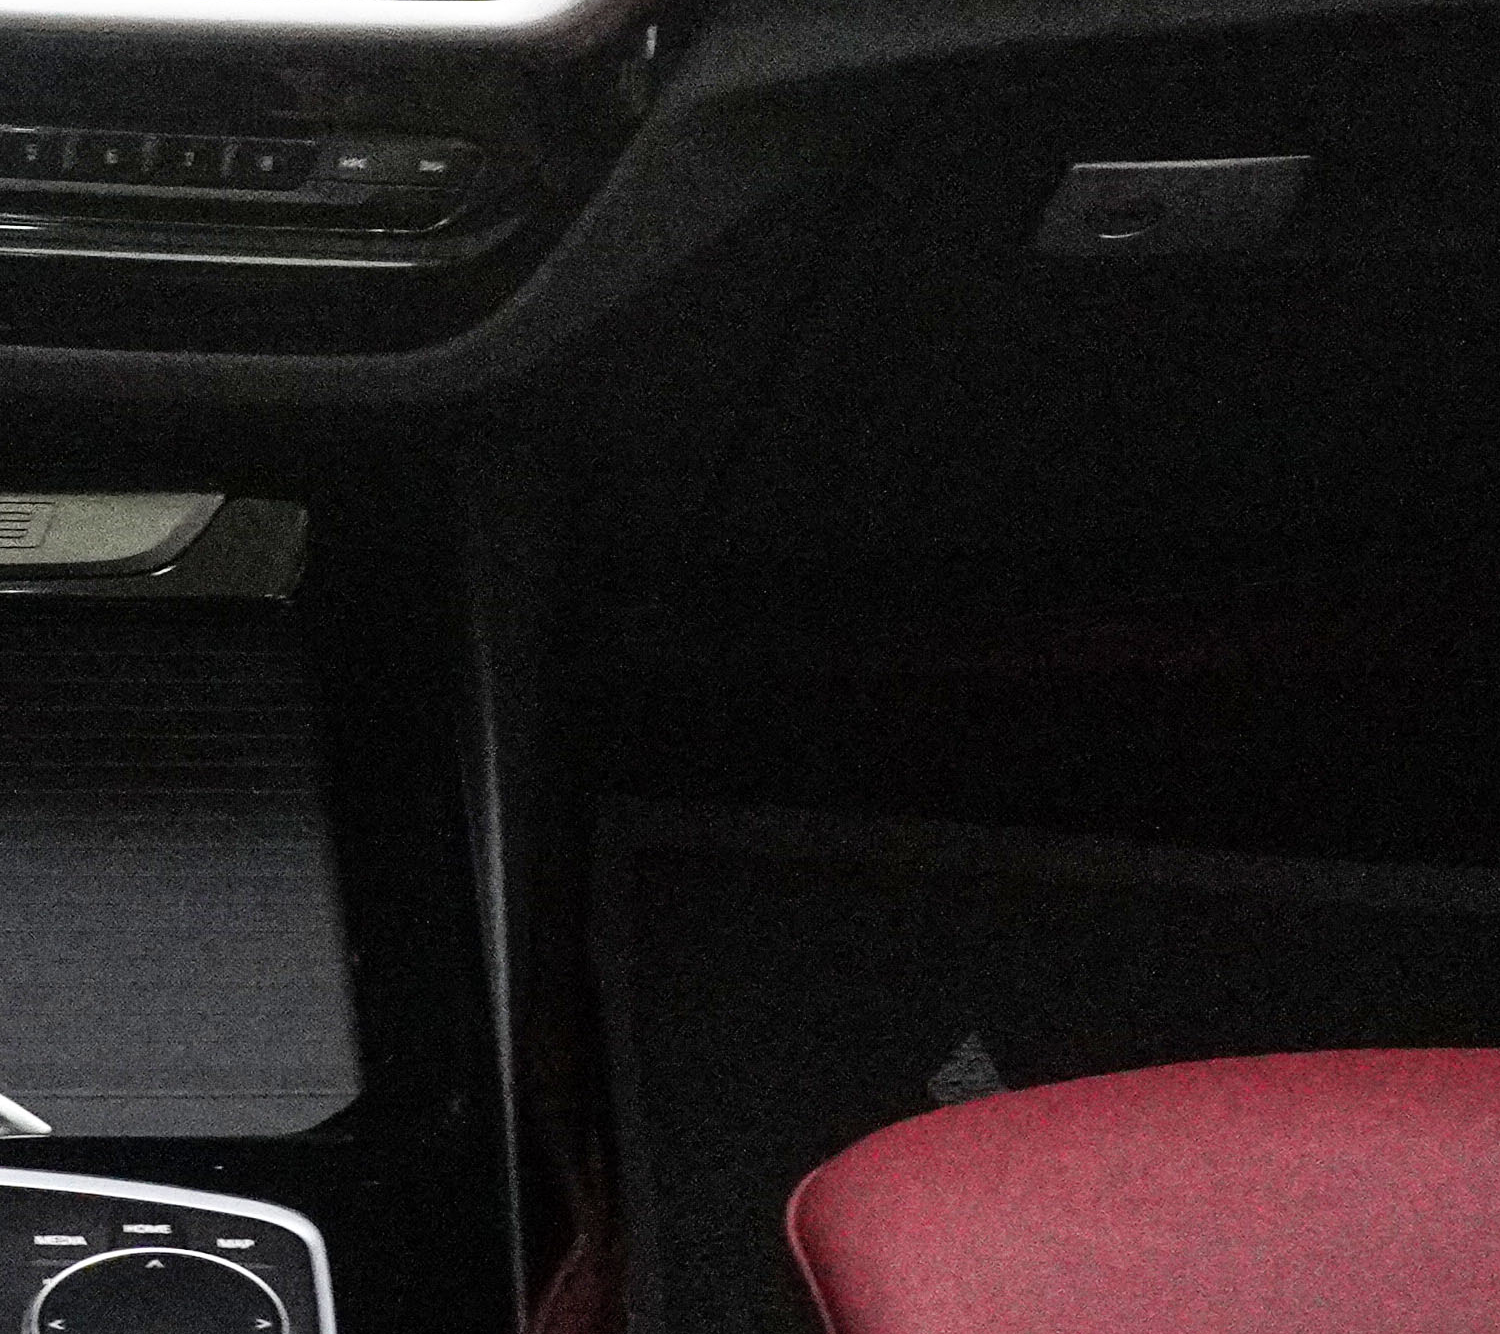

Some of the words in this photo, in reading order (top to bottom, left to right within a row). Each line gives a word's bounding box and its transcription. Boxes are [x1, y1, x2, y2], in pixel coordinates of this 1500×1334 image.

[122, 1224, 173, 1234] HOME
[34, 1235, 88, 1247] MEDIA
[216, 1238, 256, 1249] MAP
